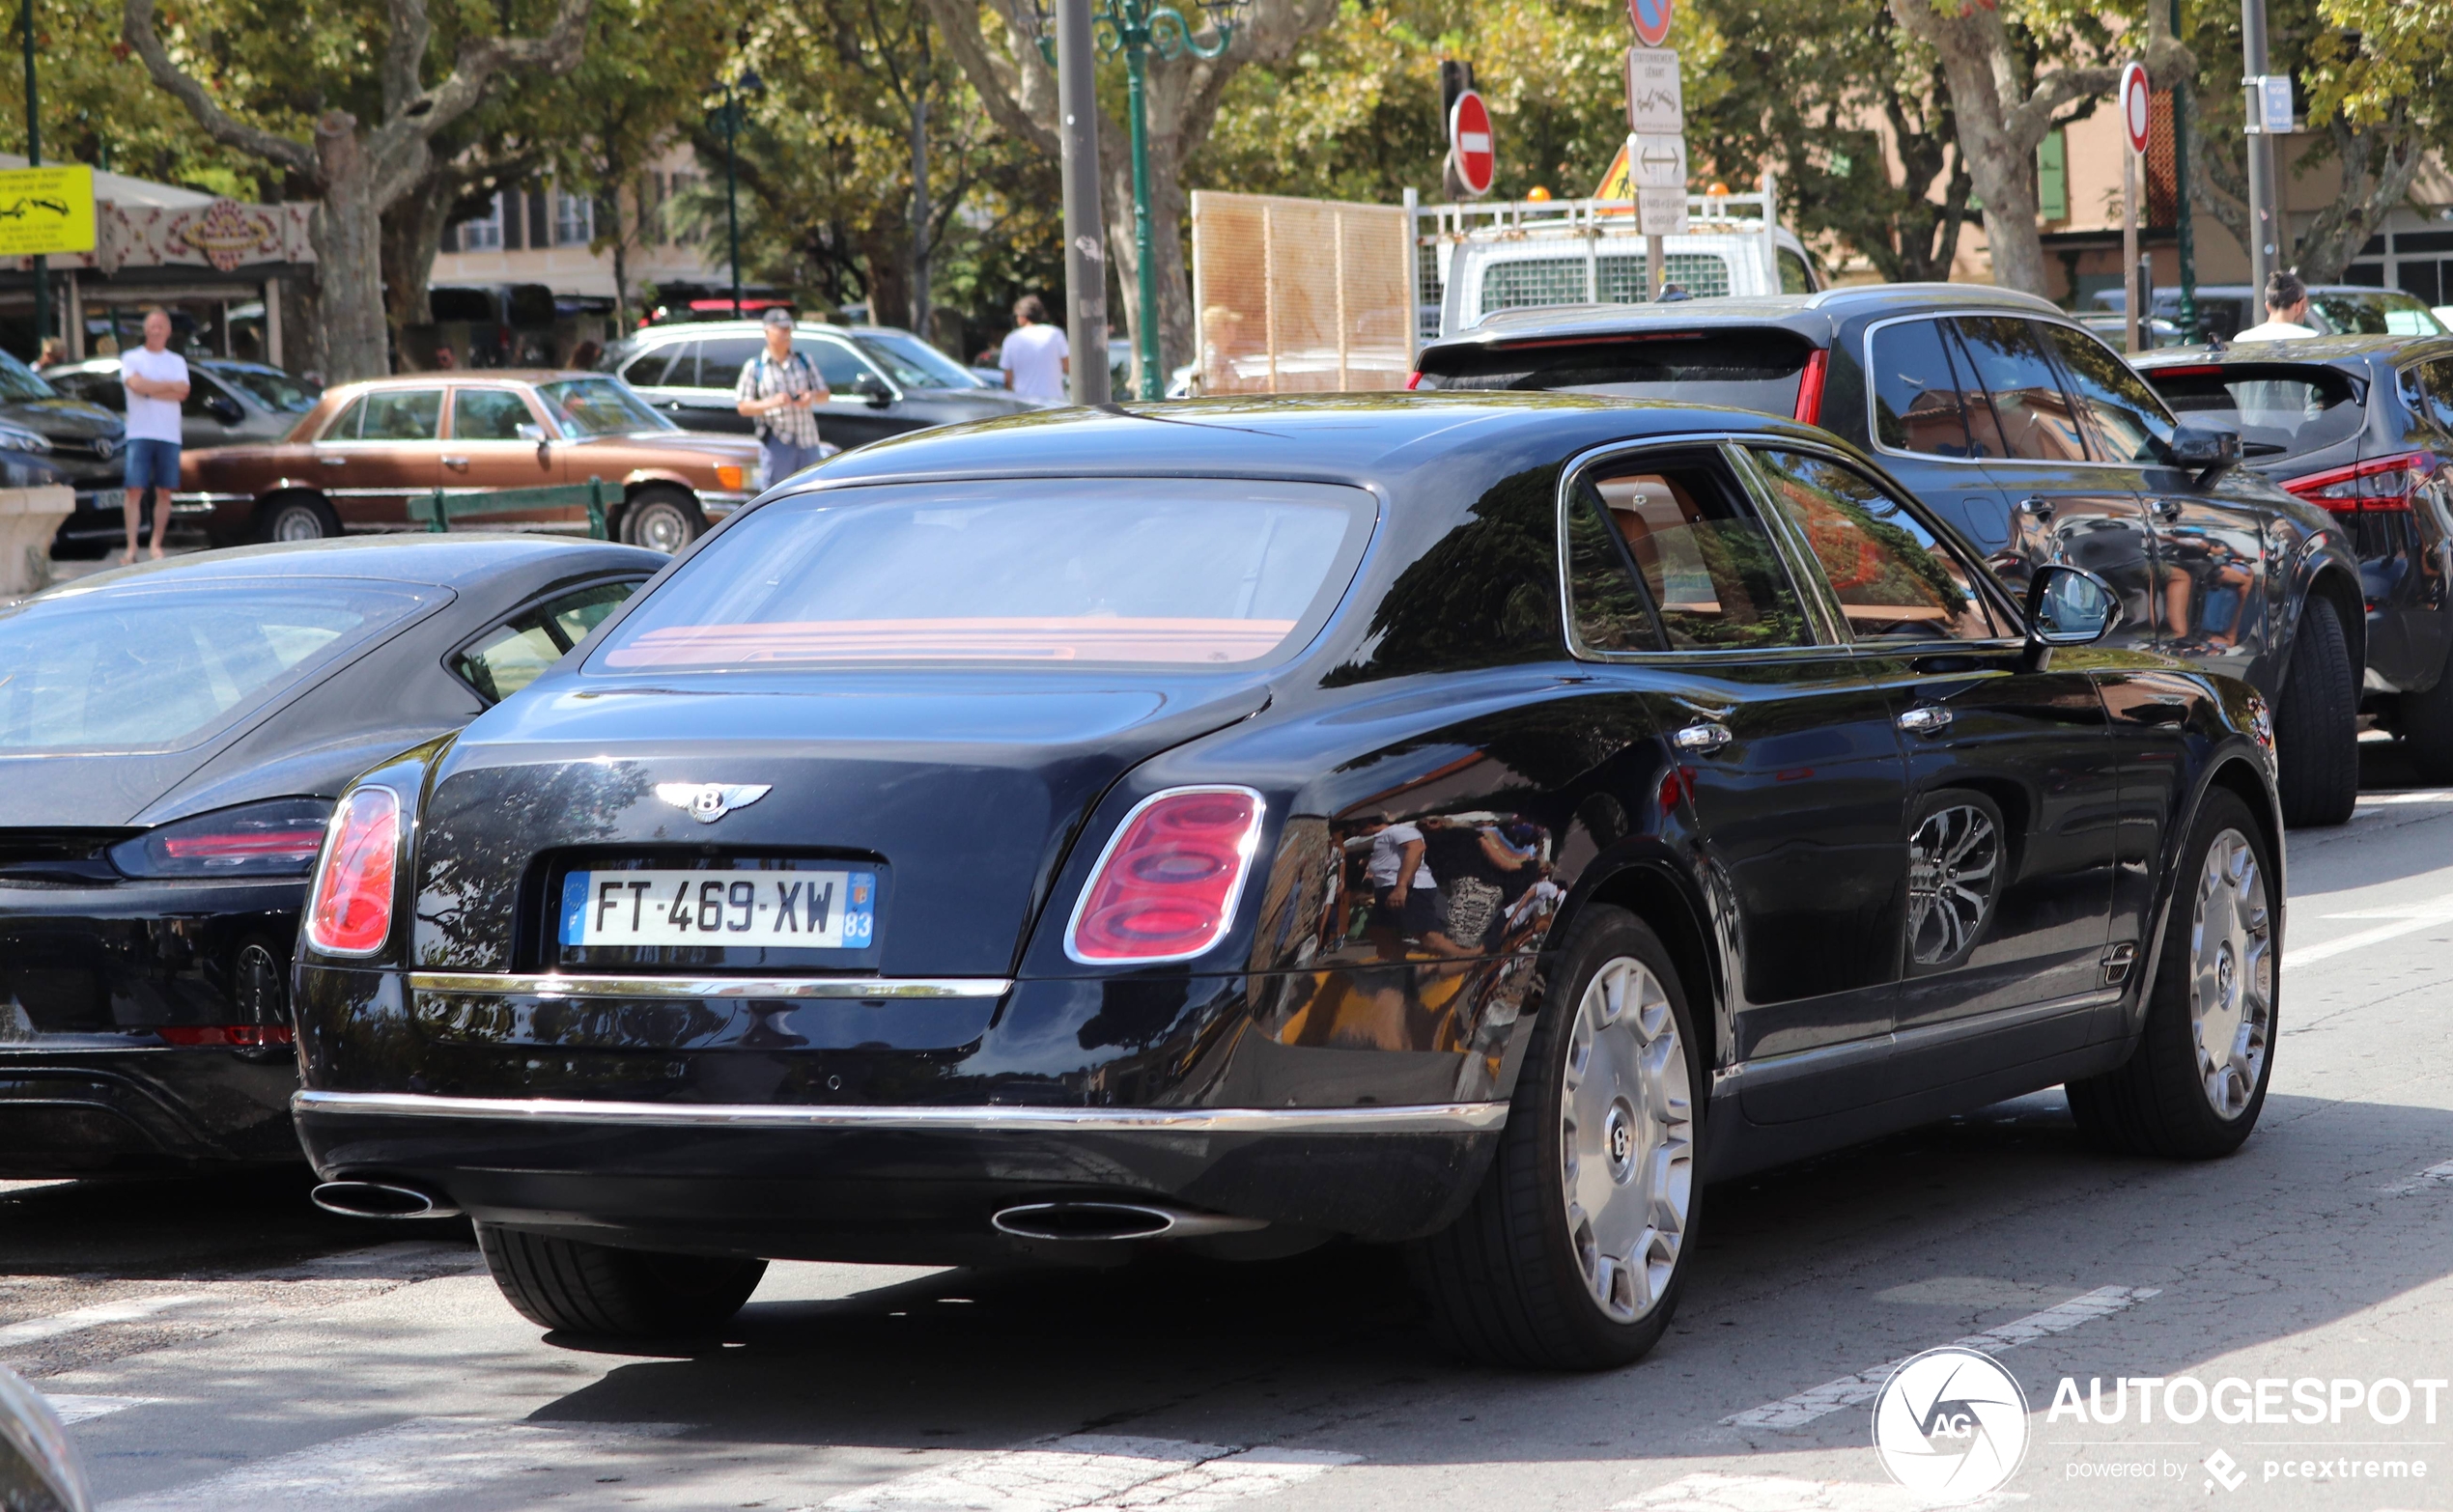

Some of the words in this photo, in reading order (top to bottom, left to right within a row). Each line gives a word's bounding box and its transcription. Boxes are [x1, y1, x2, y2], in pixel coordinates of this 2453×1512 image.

[1633, 52, 1675, 64] STATIONNEMENT
[596, 882, 833, 933] FT-469-XW
[844, 911, 871, 938] 83
